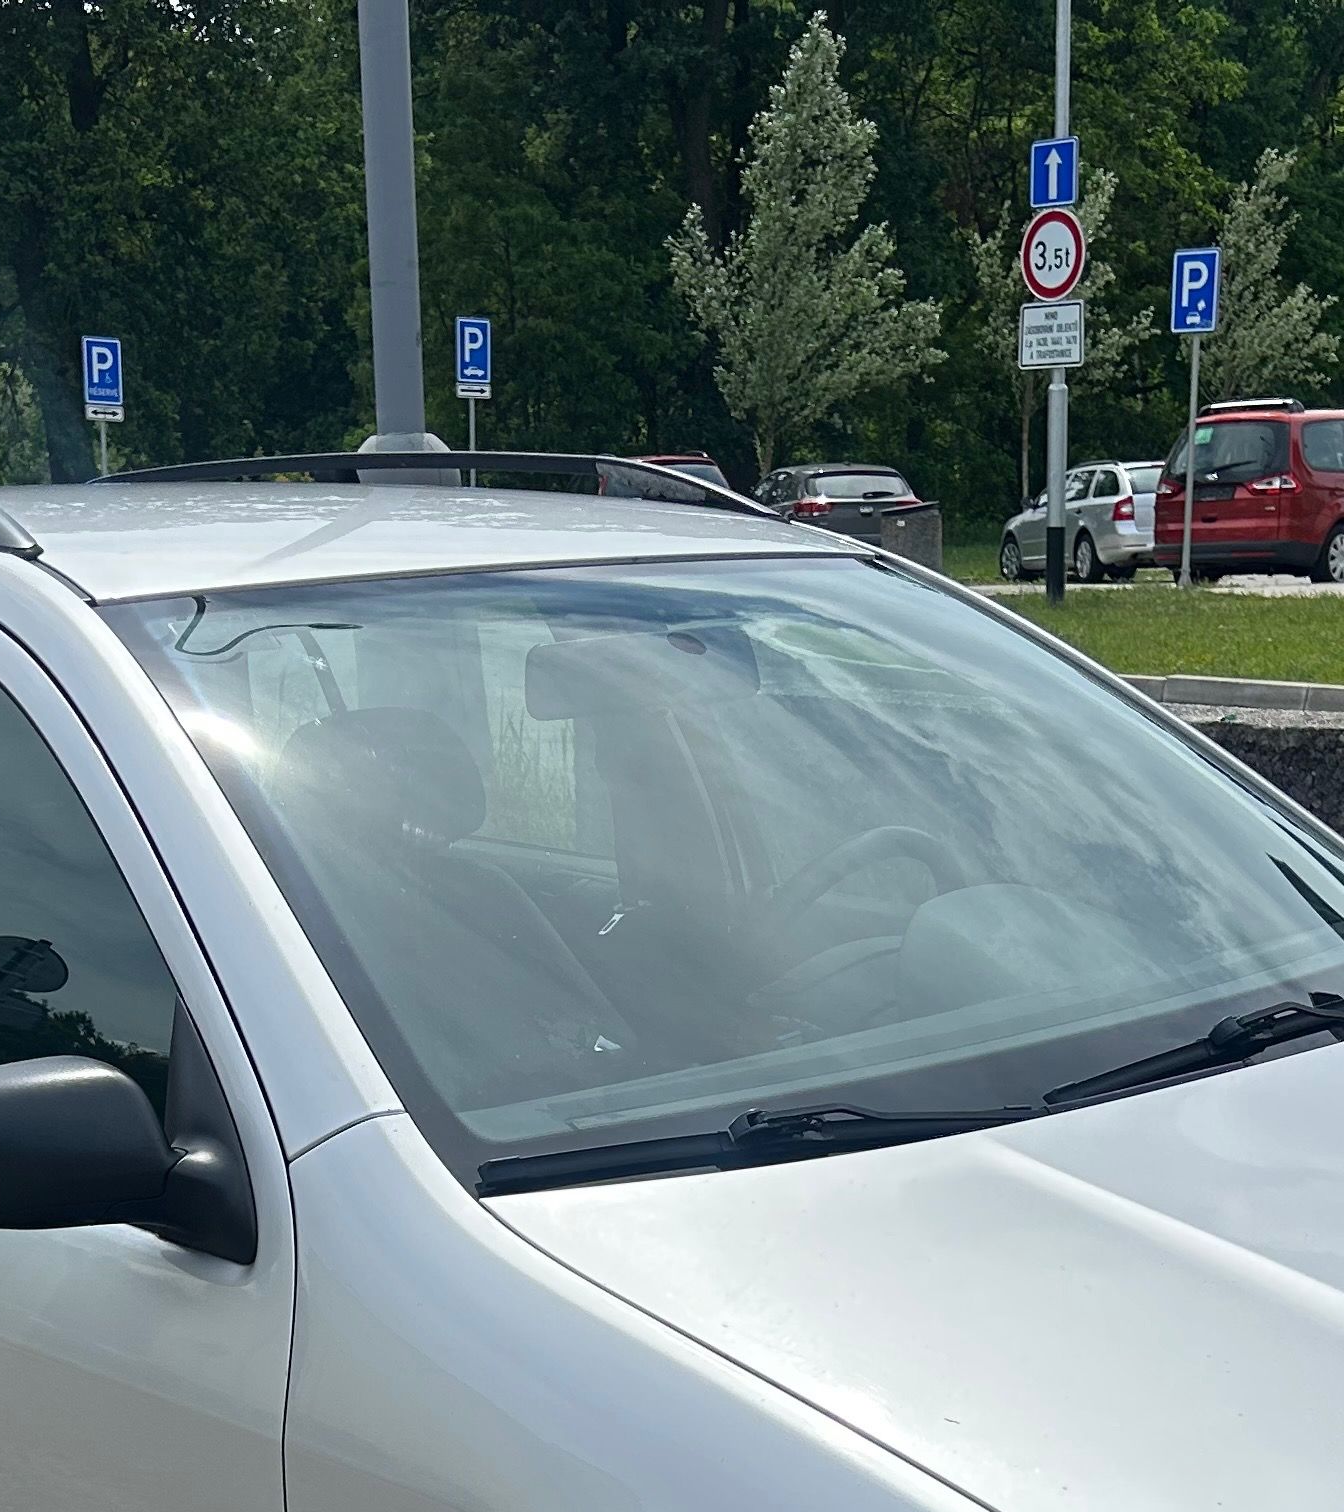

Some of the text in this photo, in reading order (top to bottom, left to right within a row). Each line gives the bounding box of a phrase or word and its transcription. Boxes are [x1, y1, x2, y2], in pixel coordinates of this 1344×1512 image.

[1034, 241, 1070, 272] 3,5t
[1181, 261, 1209, 308] P
[464, 326, 484, 363] P
[92, 345, 114, 383] P
